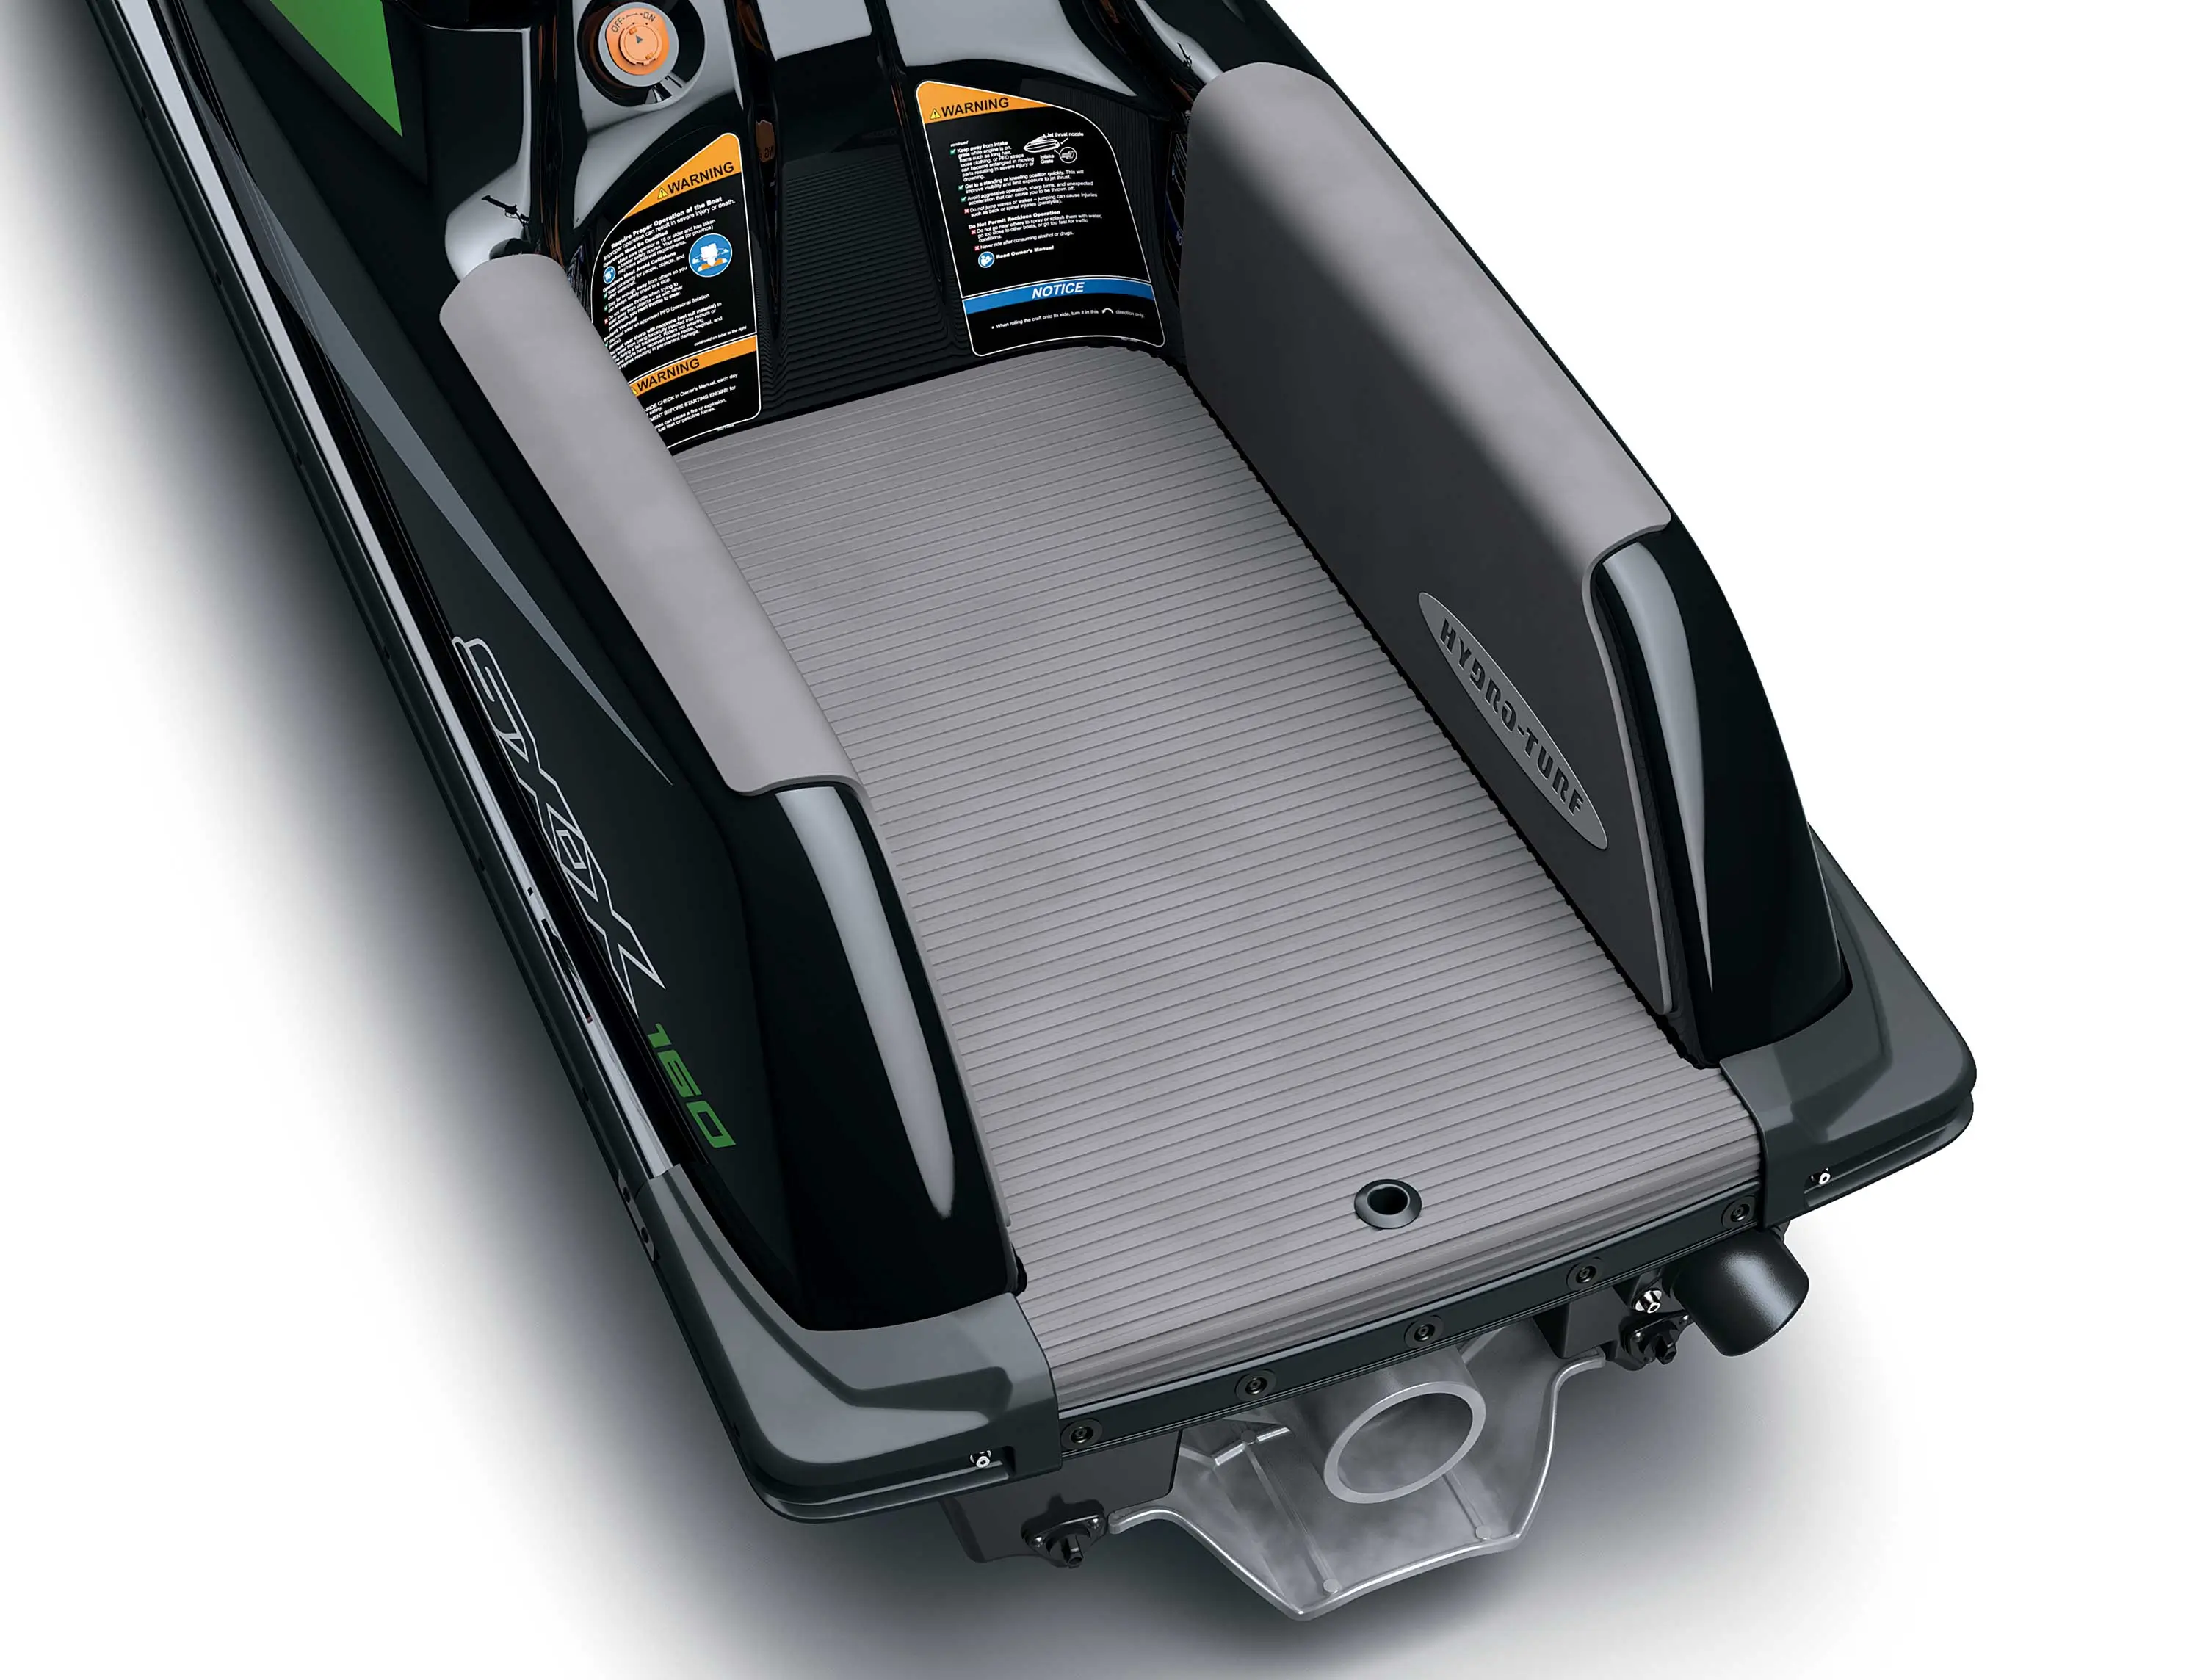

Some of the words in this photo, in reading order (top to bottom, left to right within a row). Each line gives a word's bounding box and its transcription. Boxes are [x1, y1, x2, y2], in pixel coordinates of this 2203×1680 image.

[611, 17, 623, 33] OFF
[643, 11, 656, 22] ON
[941, 97, 1009, 117] WARNING
[667, 162, 734, 194] WARNING
[969, 197, 995, 205] acceleration
[980, 190, 1005, 199] aggressive
[604, 245, 622, 261] Improper
[623, 234, 645, 248] operation
[656, 222, 670, 232] result
[676, 213, 695, 223] severe
[695, 207, 710, 216] injury
[718, 200, 735, 208] death.
[611, 234, 632, 249] Require
[632, 224, 653, 236] Proper
[654, 211, 684, 226] Operation
[706, 197, 723, 206] Boat
[603, 253, 624, 268] Operators
[625, 245, 636, 254] Must
[645, 230, 668, 244] Qualified
[603, 277, 623, 293] Operators
[623, 269, 635, 279] Must
[636, 262, 650, 272] Avoid
[651, 252, 676, 264] Collisions
[1031, 281, 1085, 299] NOTICE
[637, 358, 701, 392] WARNING
[658, 395, 675, 406] CHECK
[680, 387, 698, 397] Owner's
[698, 380, 717, 389] Manual,
[664, 403, 684, 416] BEFORE
[684, 394, 709, 407] STARTING
[709, 388, 729, 398] ENGINE
[673, 413, 687, 421] cause
[703, 398, 727, 409] explosion.
[681, 413, 700, 423] gasoline
[1439, 618, 1584, 816] HYDRO-TURF
[646, 1021, 737, 1148] 160
